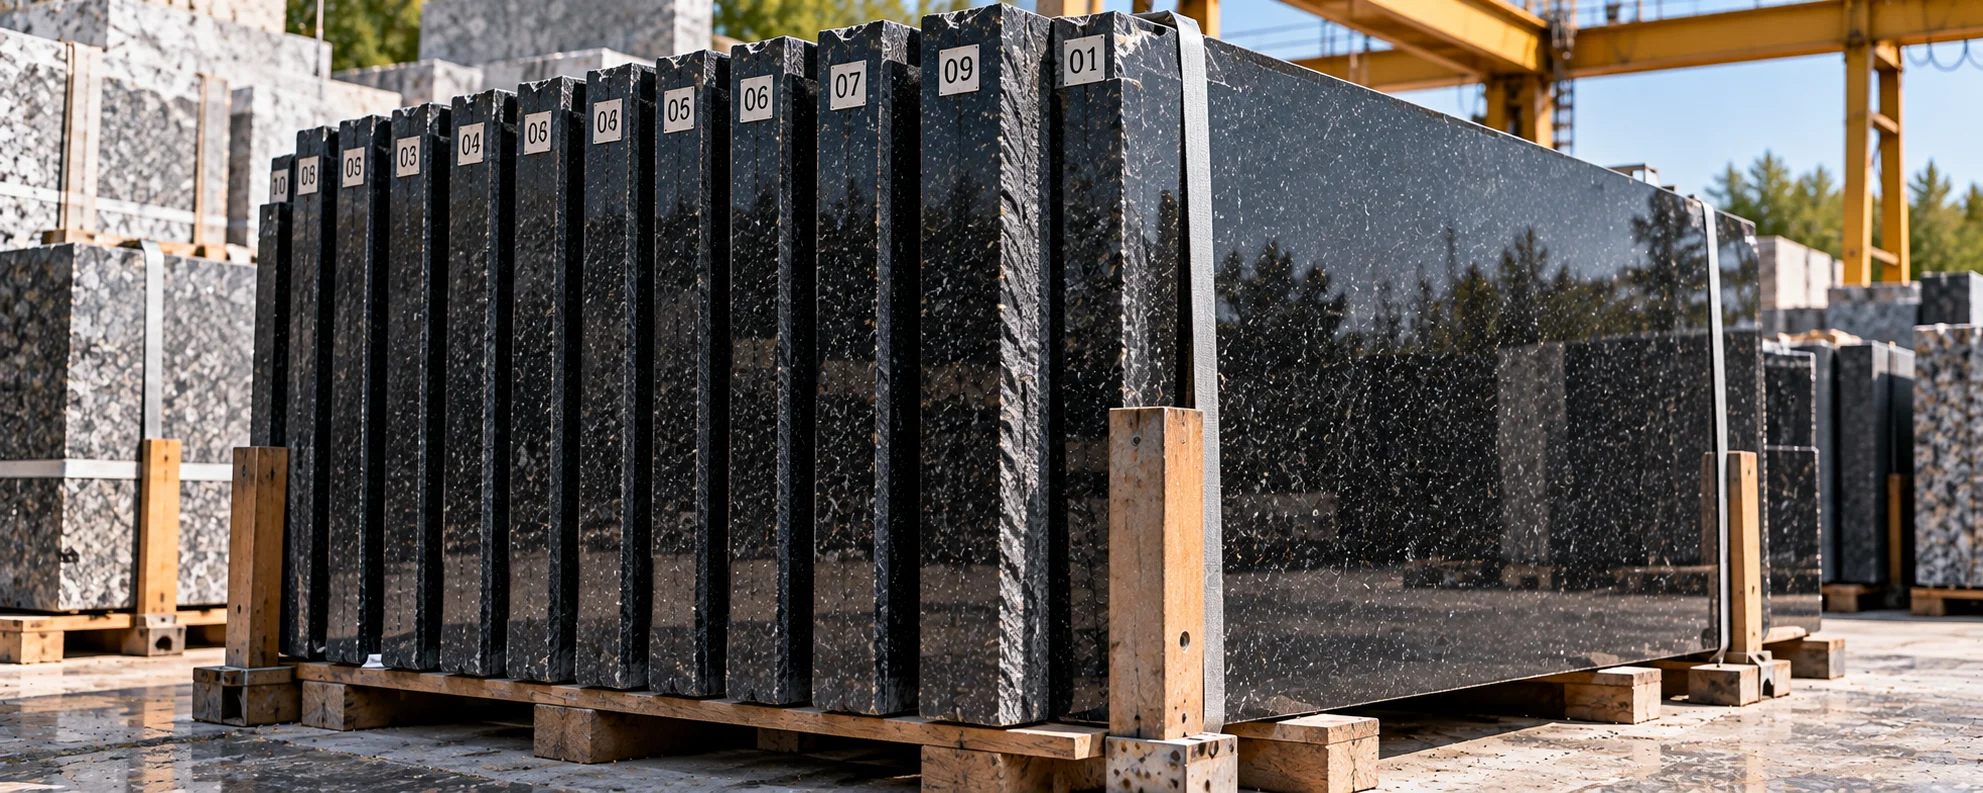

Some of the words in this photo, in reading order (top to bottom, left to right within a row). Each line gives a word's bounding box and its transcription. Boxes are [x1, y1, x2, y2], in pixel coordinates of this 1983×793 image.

[945, 56, 973, 84] 09
[1070, 47, 1097, 74] 01
[836, 71, 861, 98] 07
[668, 97, 690, 122] 05
[744, 86, 768, 111] 06
[400, 146, 416, 167] 03
[462, 132, 480, 156] 04
[273, 176, 285, 195] 10
